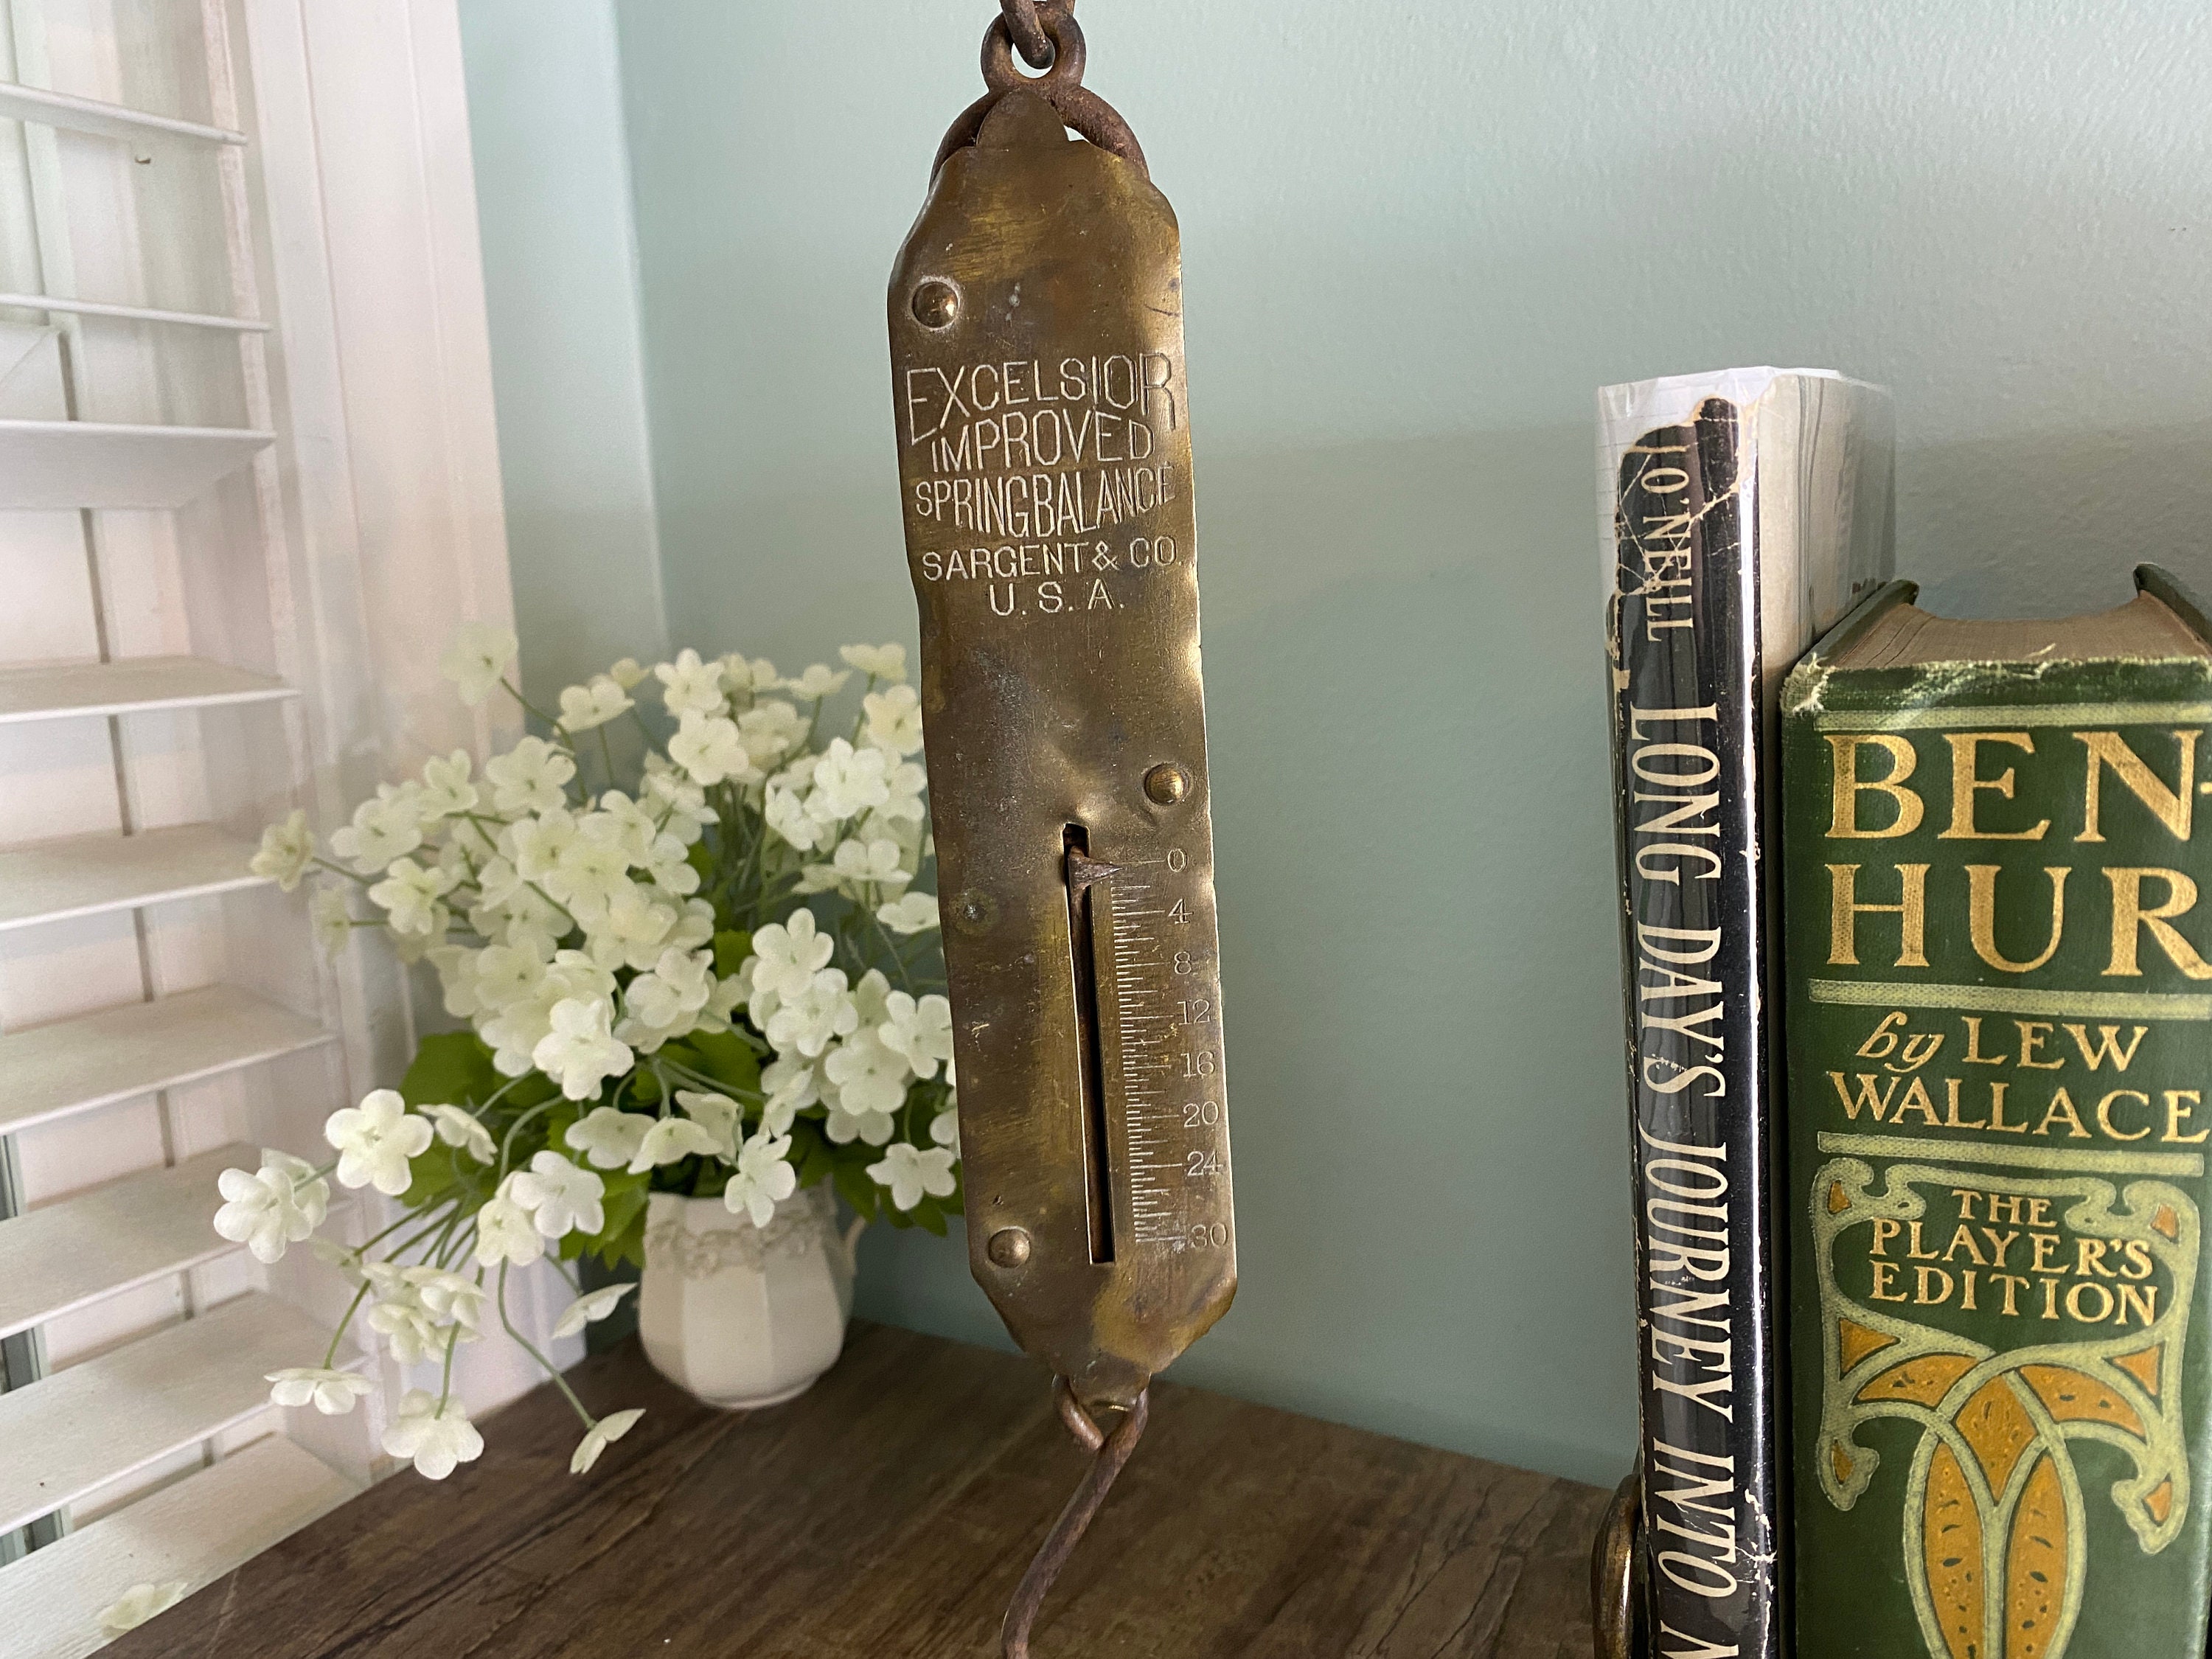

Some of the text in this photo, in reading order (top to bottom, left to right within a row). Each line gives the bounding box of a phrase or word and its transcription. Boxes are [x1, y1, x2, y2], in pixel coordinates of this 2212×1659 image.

[907, 352, 1176, 445] EXCELSIOR
[931, 409, 1155, 473] IMPROVED
[922, 535, 1178, 581] SARGENT & CO
[1630, 700, 1722, 886] LONG
[1167, 848, 1189, 872] 0
[1167, 898, 1194, 924] 4
[1824, 863, 2212, 980] HUR
[1174, 951, 1192, 975] 8
[1177, 998, 1211, 1025] 12
[1637, 920, 1726, 1098] DAY'S
[1180, 1051, 1216, 1078] 16
[1855, 1011, 2149, 1073] by LEW
[1183, 1101, 1220, 1128] 20
[1826, 1071, 2210, 1144] WALLACE
[1186, 1150, 1224, 1178] 24
[1191, 1222, 1228, 1248] 30
[1951, 1189, 2058, 1228] THE
[1638, 1118, 1733, 1424] JOURNEY
[1868, 1217, 2154, 1280] PLAYER'S
[1868, 1259, 2158, 1326] EDITION
[1653, 1436, 1739, 1599] INTO
